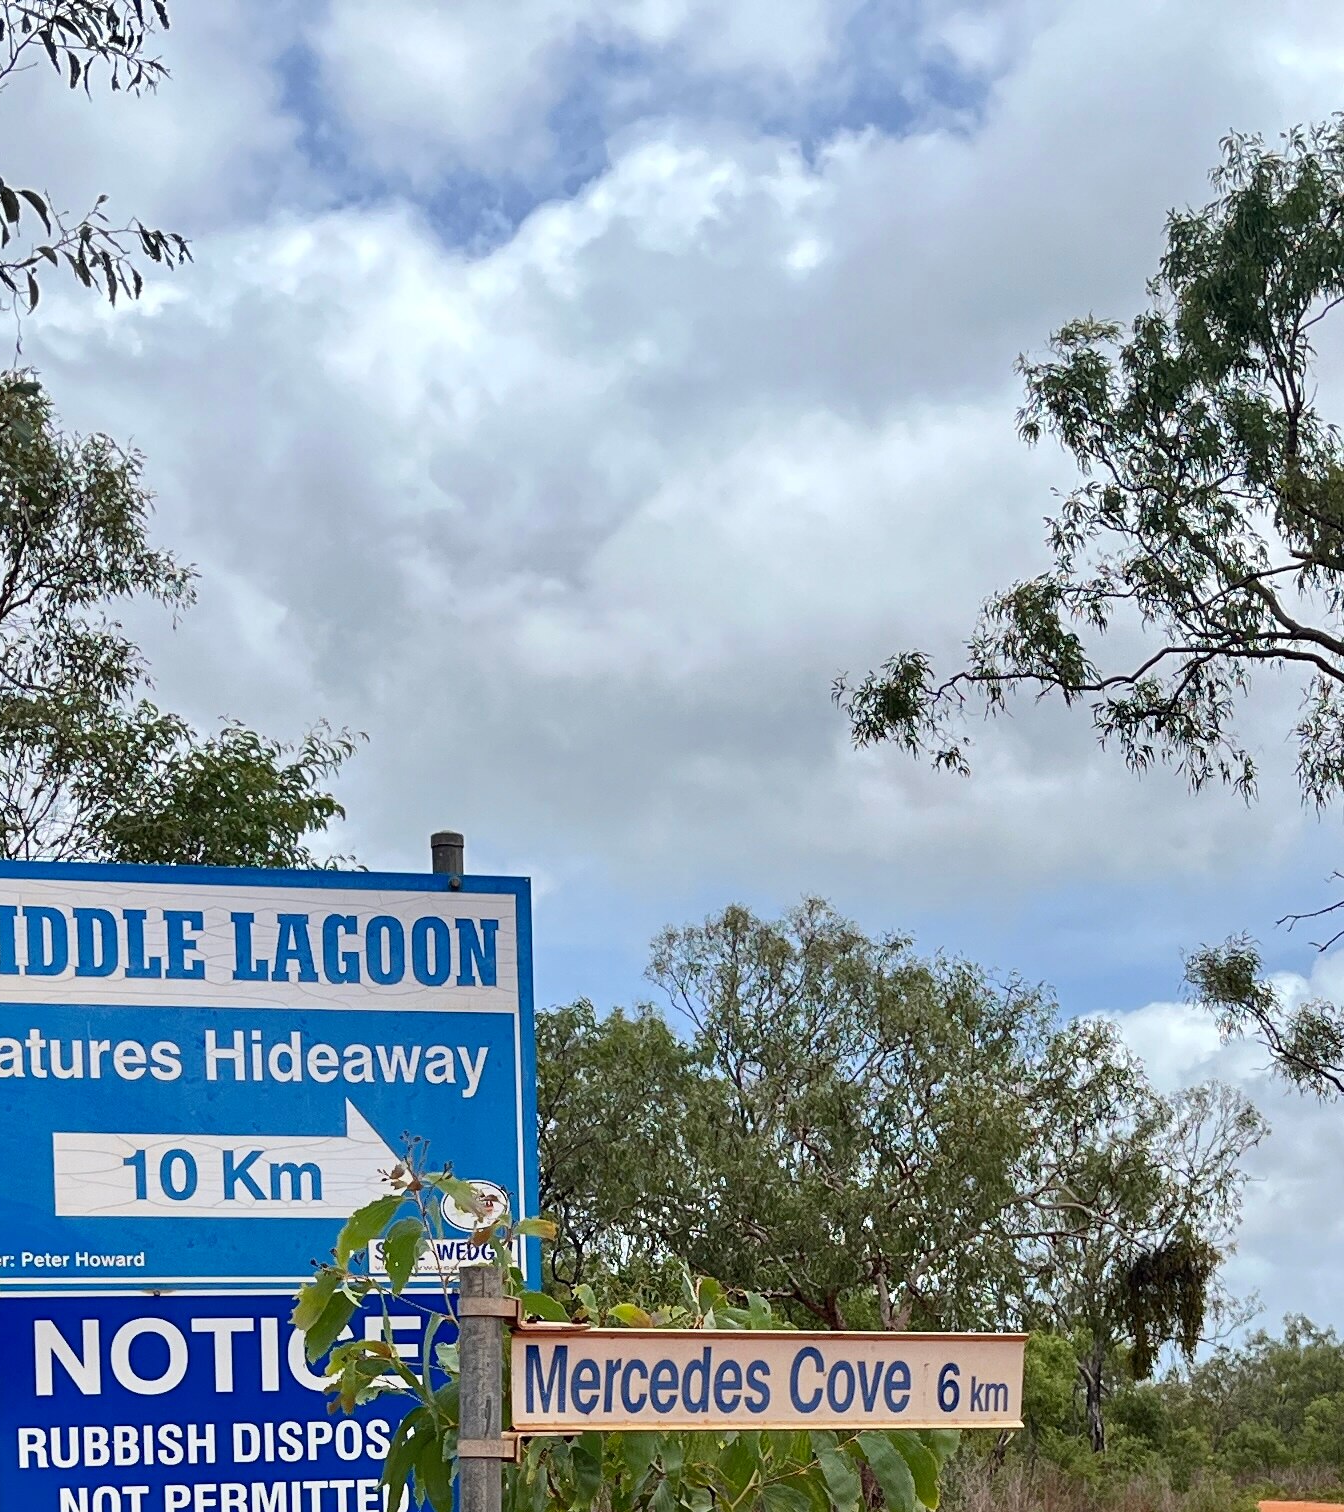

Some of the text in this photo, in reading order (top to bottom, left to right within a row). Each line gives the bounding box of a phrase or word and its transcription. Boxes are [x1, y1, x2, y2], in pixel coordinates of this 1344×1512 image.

[231, 911, 499, 988] LAGOON
[205, 1029, 489, 1099] Hideaway
[123, 1148, 323, 1201] 10 Km
[21, 1252, 70, 1268] Peter
[75, 1252, 145, 1268] Howard
[34, 1315, 423, 1396] NOTICE
[525, 1344, 1009, 1415] Mercedes Cove 6 km
[18, 1419, 415, 1469] RUBBISH DISPOS
